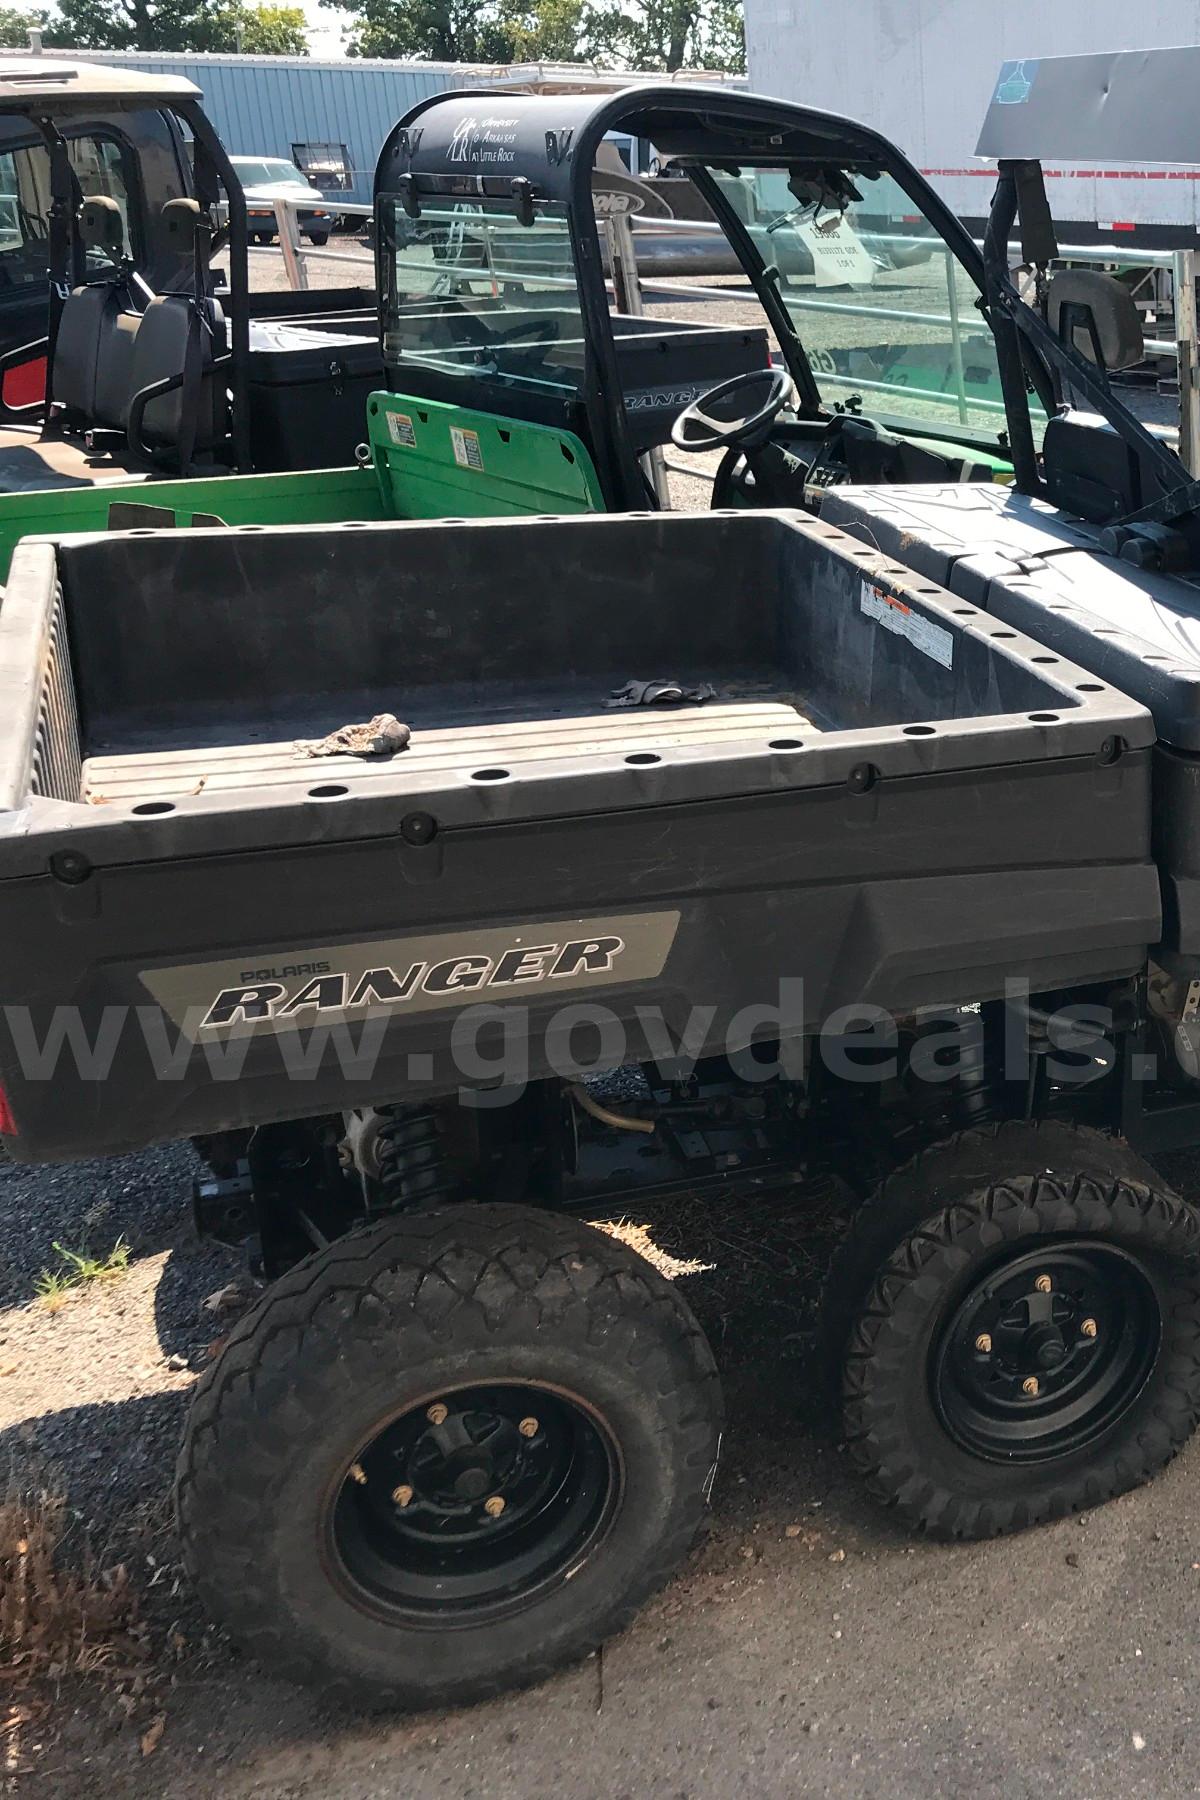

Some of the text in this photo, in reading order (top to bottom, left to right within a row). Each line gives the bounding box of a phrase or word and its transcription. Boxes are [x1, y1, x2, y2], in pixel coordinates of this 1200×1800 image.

[480, 147, 497, 162] LITTLE
[497, 147, 516, 162] ROCK
[623, 387, 713, 410] RANGE
[199, 935, 626, 1029] RANGER
[240, 961, 331, 983] POLARIS
